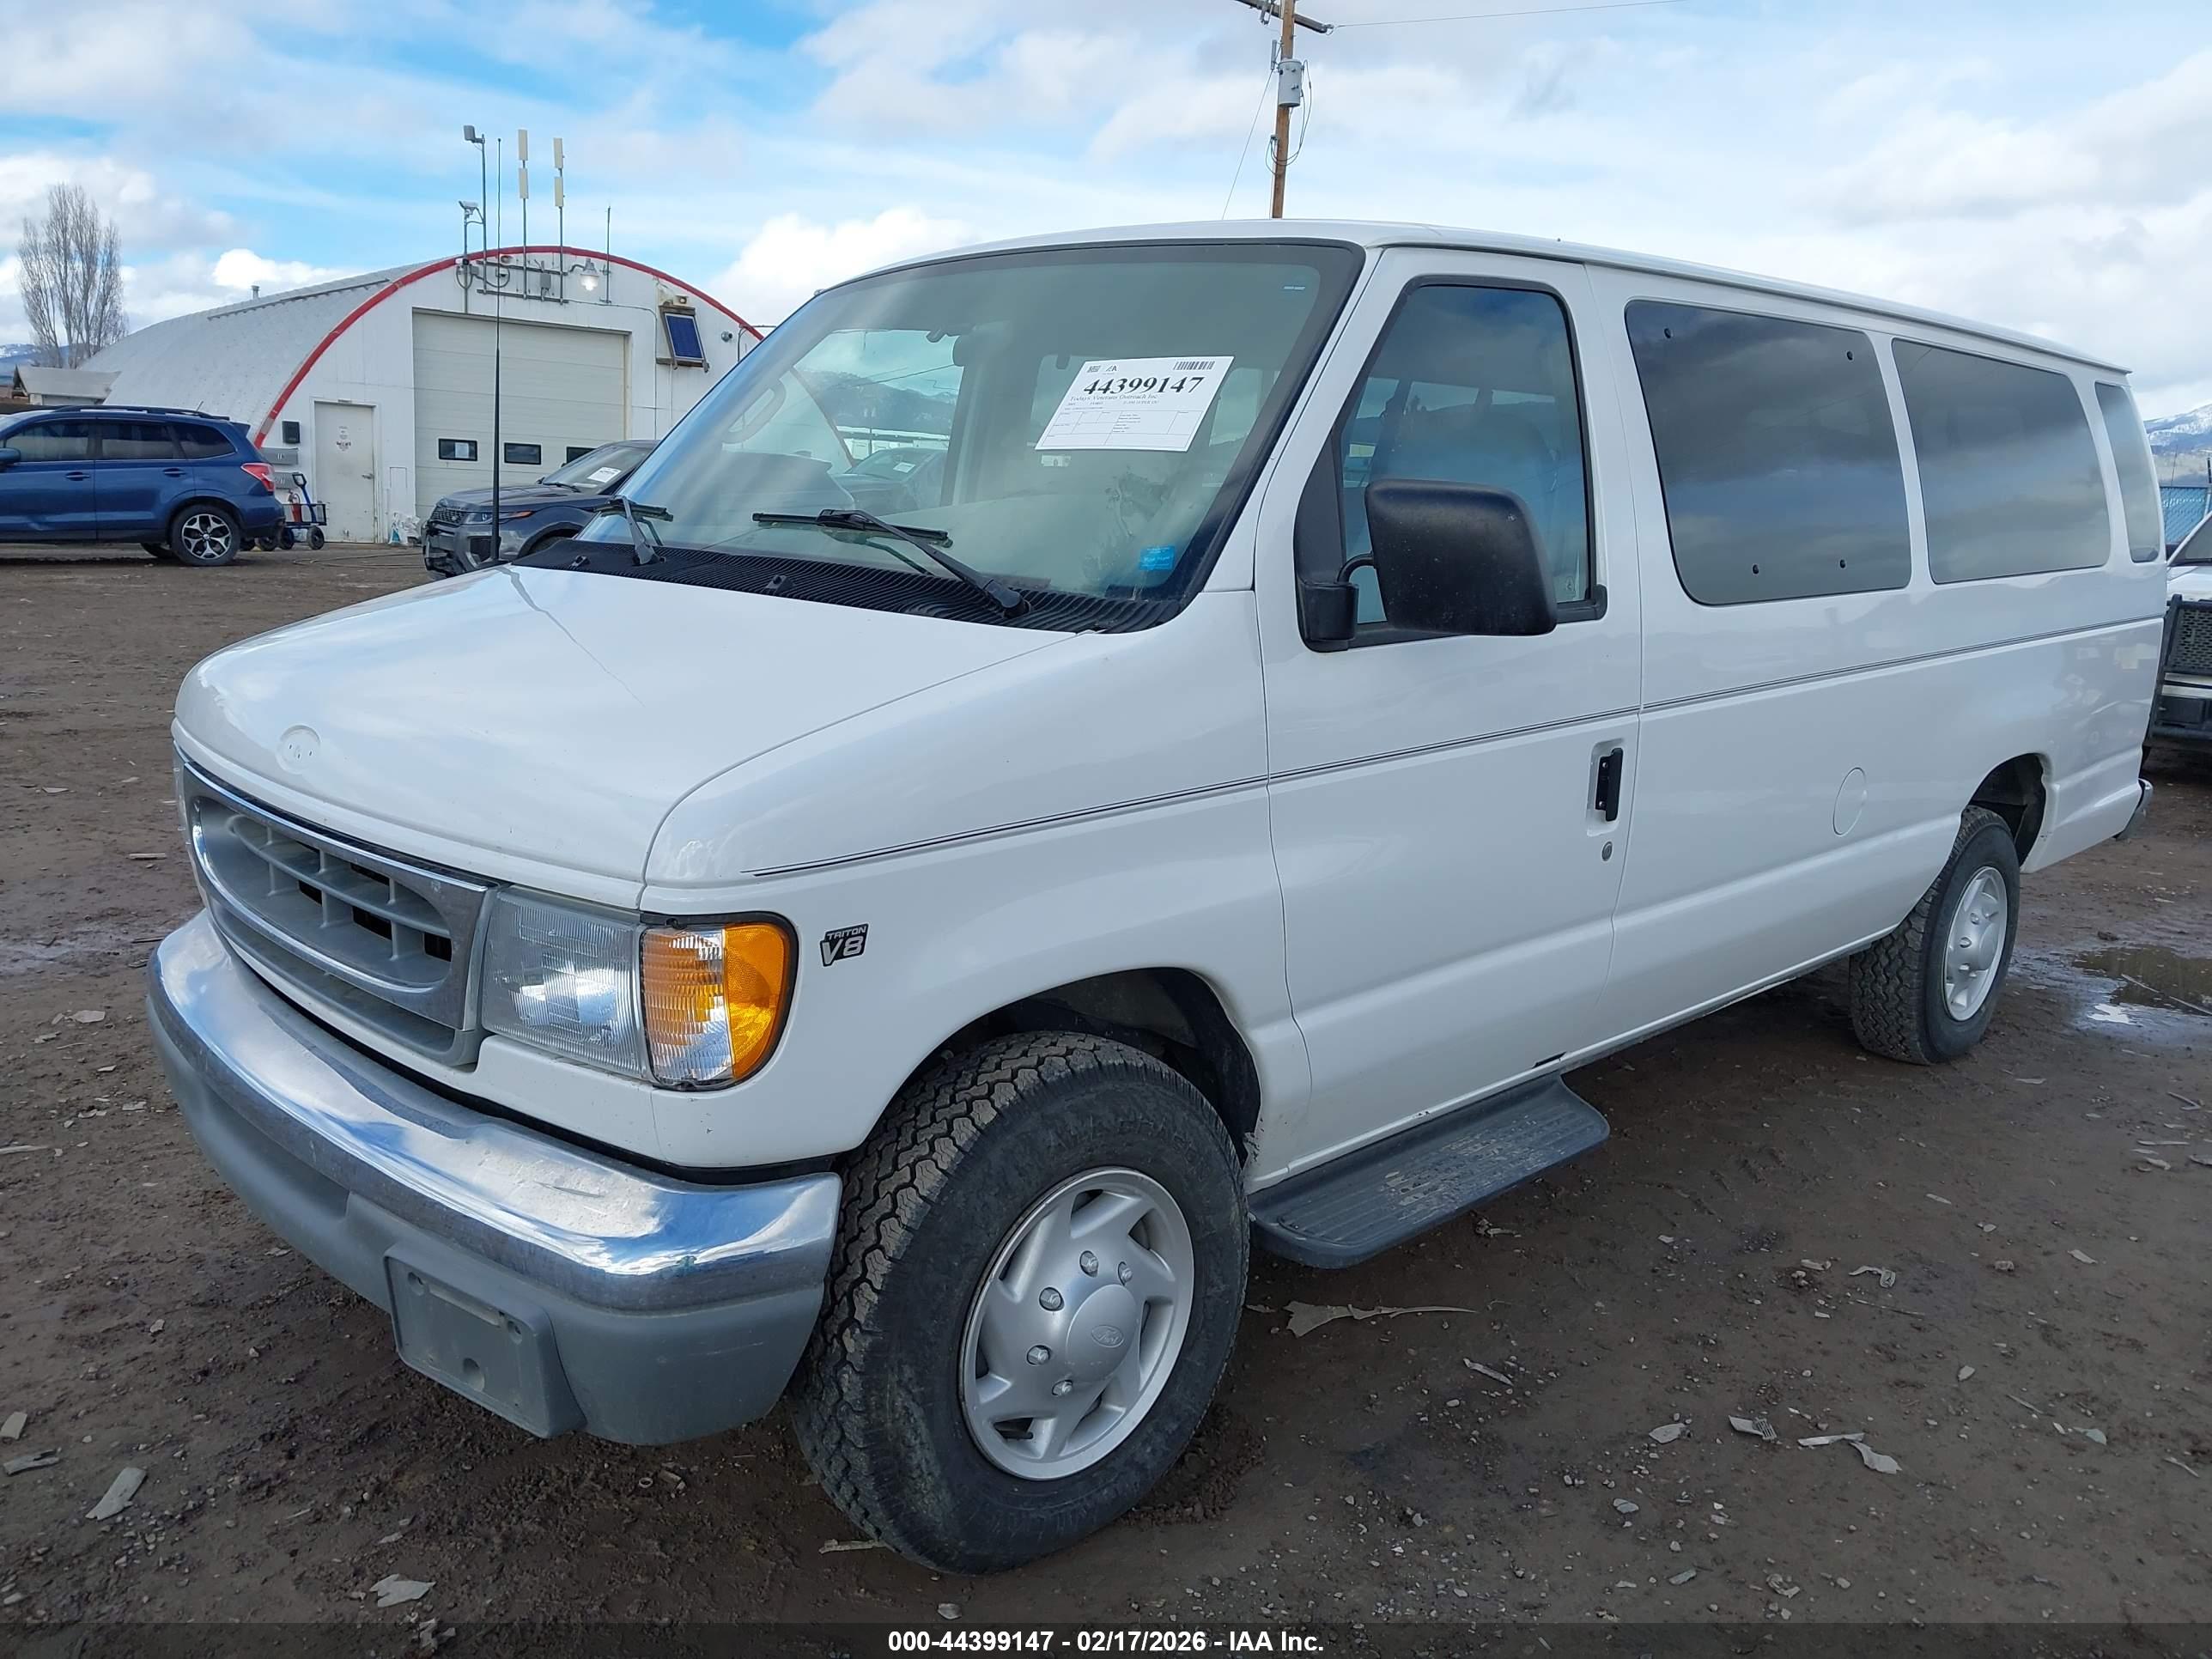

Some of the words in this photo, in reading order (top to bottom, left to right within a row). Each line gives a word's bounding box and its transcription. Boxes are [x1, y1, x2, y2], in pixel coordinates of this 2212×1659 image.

[1084, 376, 1206, 394] 44399147
[827, 926, 866, 940] TRITON
[822, 936, 864, 964] V8
